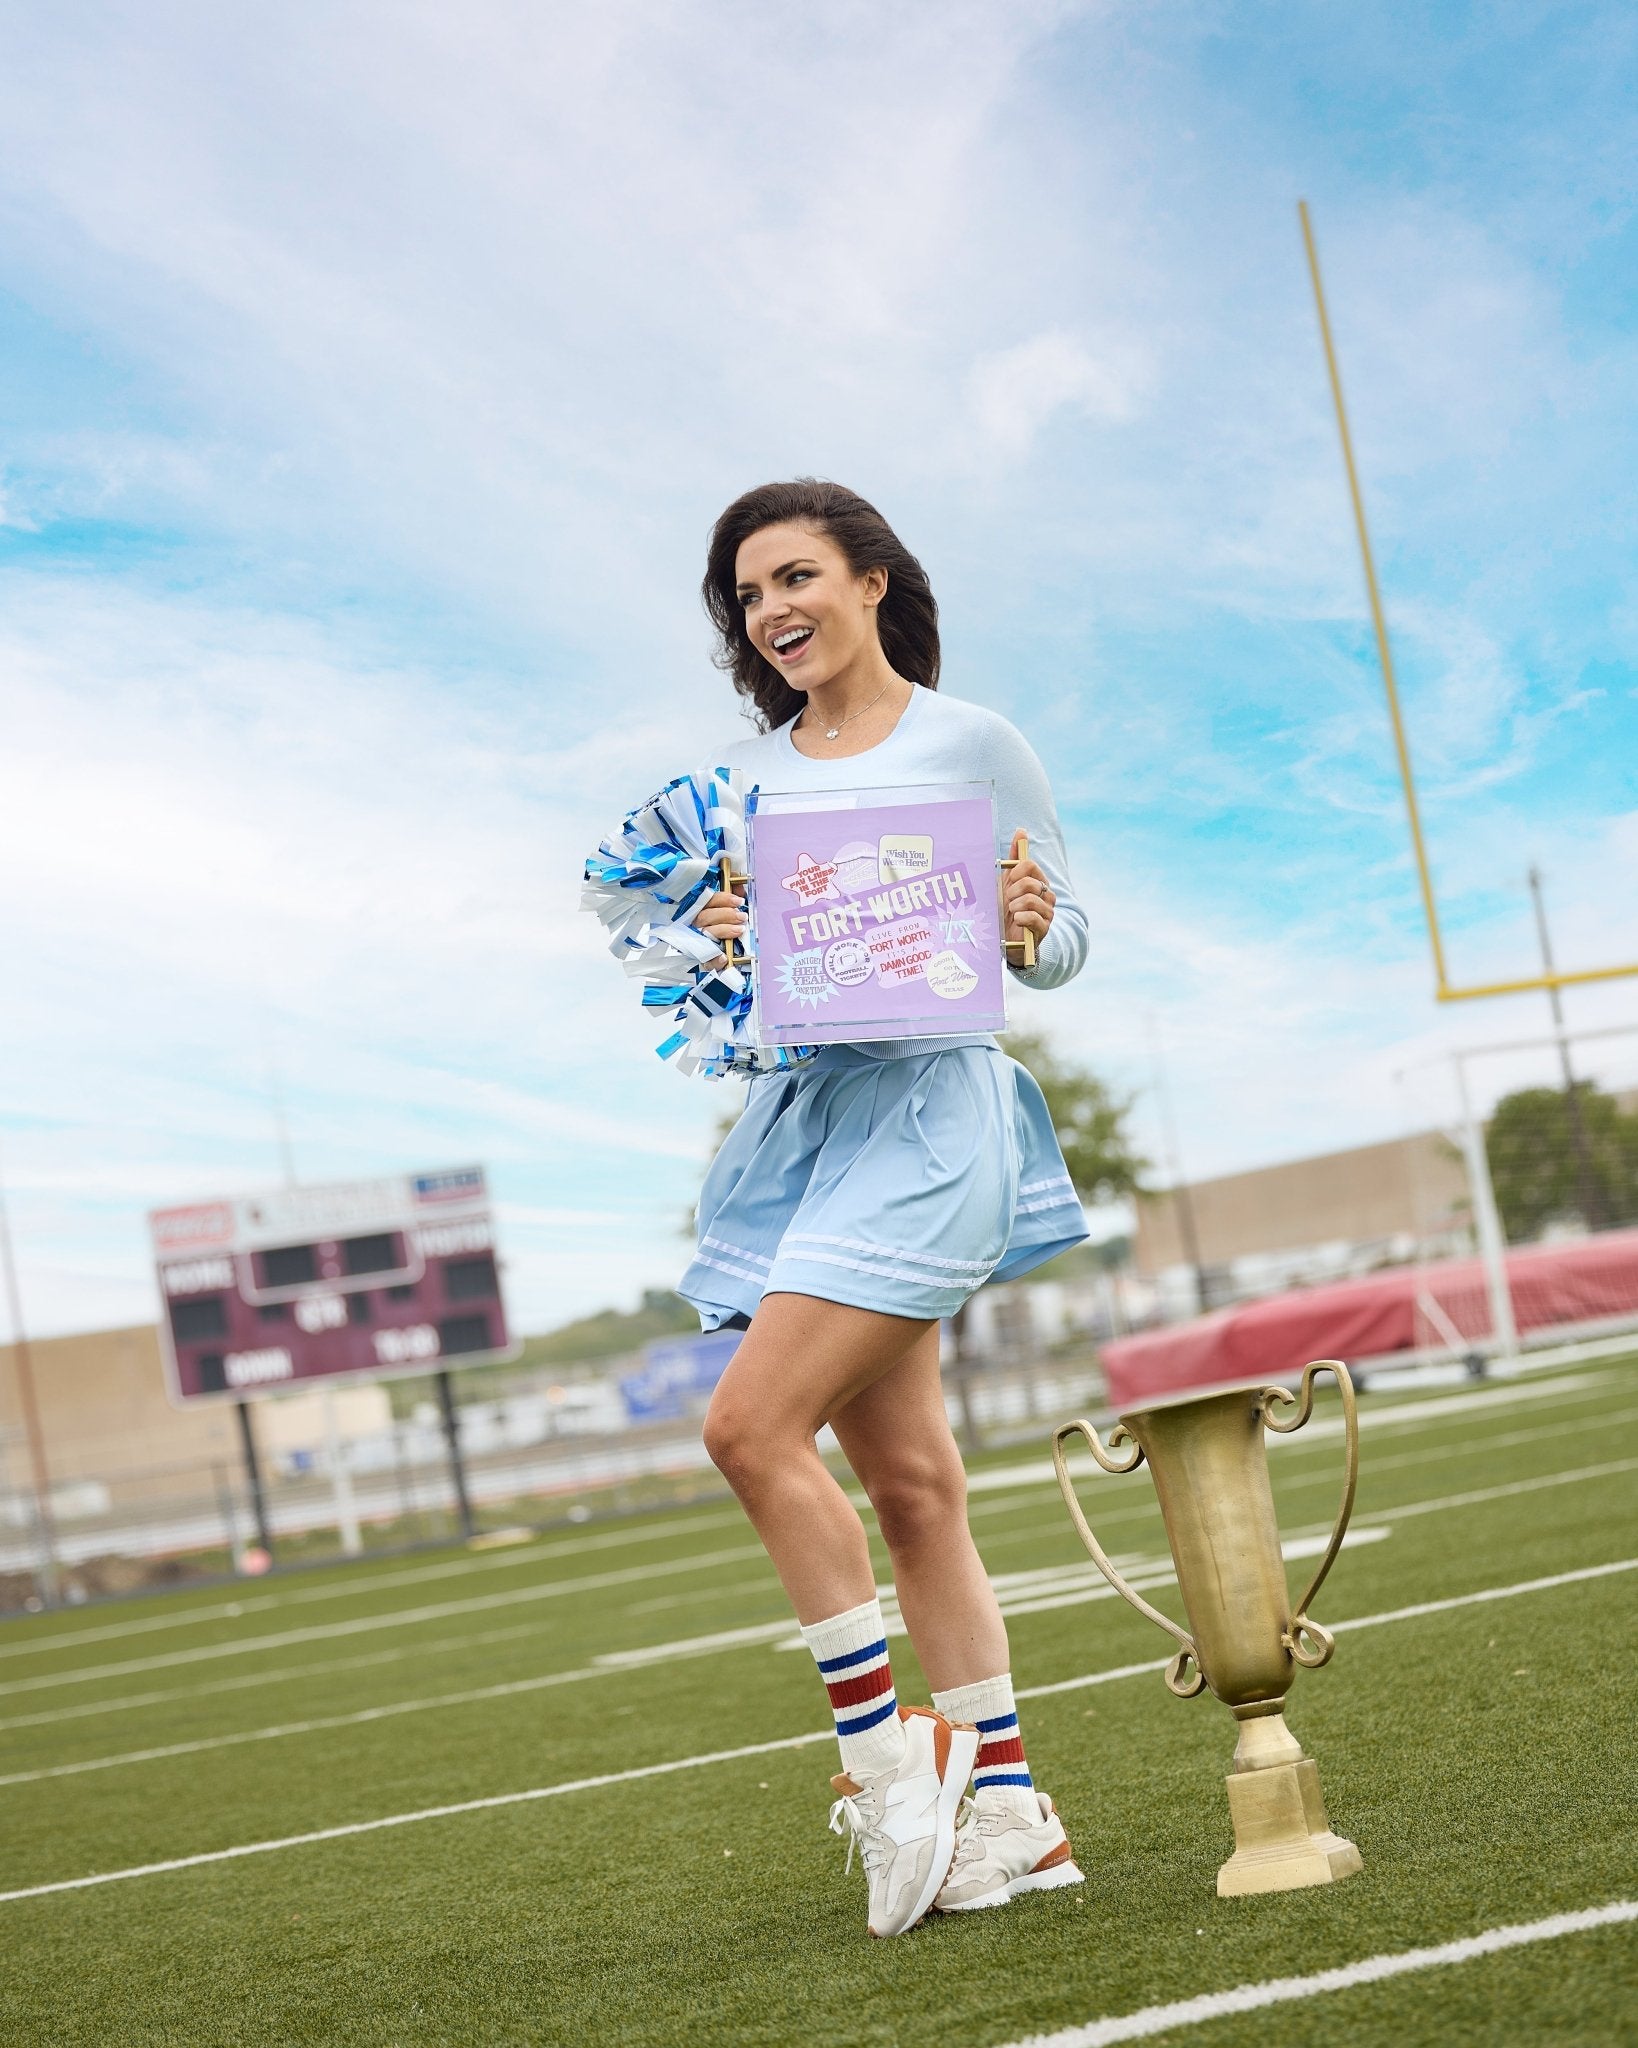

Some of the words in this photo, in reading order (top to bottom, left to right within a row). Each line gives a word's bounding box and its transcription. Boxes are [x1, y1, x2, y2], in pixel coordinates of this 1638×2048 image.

[886, 849, 908, 859] Wish
[909, 850, 925, 859] You
[905, 859, 929, 867] Here!
[798, 865, 820, 878] YOUR
[790, 878, 806, 889] FAV
[799, 885, 809, 893] IN
[810, 877, 829, 888] THE
[805, 884, 828, 897] FORT
[790, 901, 863, 946] FORT
[867, 870, 968, 924] WORTH
[871, 930, 892, 941] LIVE
[899, 922, 920, 934] FROM
[869, 939, 894, 955] FORT
[897, 930, 932, 947] WORTH
[880, 957, 906, 973] DAMN
[906, 950, 932, 965] GOOD
[835, 965, 869, 977] FOOTBALL
[894, 964, 924, 979] TIME!
[791, 975, 831, 985] YEAH
